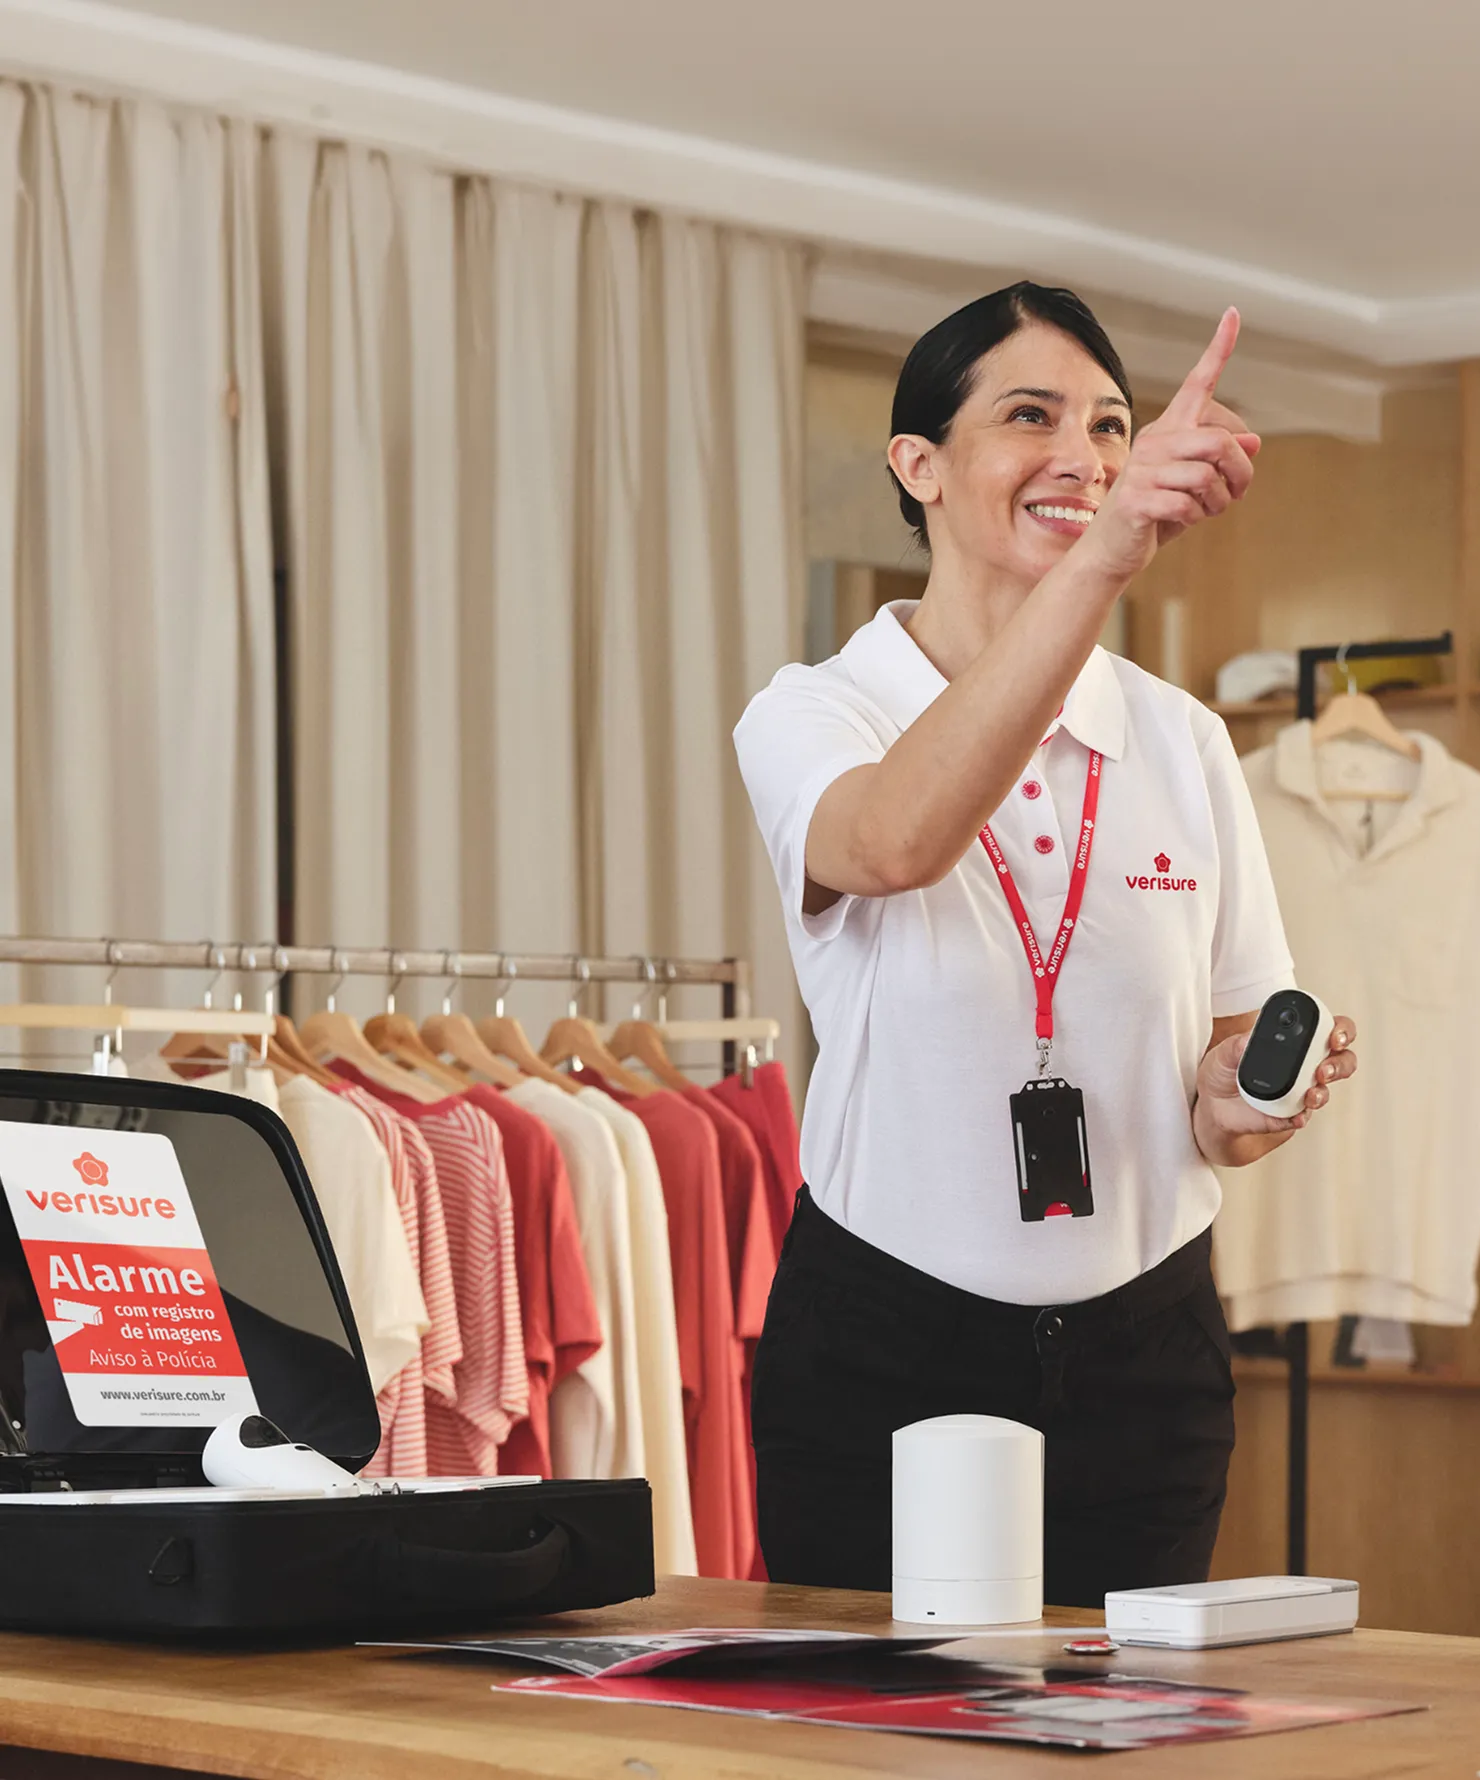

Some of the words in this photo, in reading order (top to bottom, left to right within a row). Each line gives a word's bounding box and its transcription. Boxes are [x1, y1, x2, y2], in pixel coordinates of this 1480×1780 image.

[1091, 752, 1100, 777] isure
[1077, 829, 1092, 870] verisure
[1125, 875, 1197, 891] verisure
[1022, 921, 1041, 966] verisure
[1047, 930, 1069, 974] verisure
[25, 1189, 176, 1219] verisure
[49, 1253, 206, 1296] Alarme
[114, 1305, 149, 1317] com
[151, 1303, 215, 1322] registro
[120, 1323, 144, 1339] de
[145, 1322, 222, 1345] imagens
[89, 1348, 137, 1367] Aviso
[141, 1349, 153, 1367] à
[156, 1350, 217, 1369] Polícia
[100, 1388, 226, 1402] www.verisure.com.br
